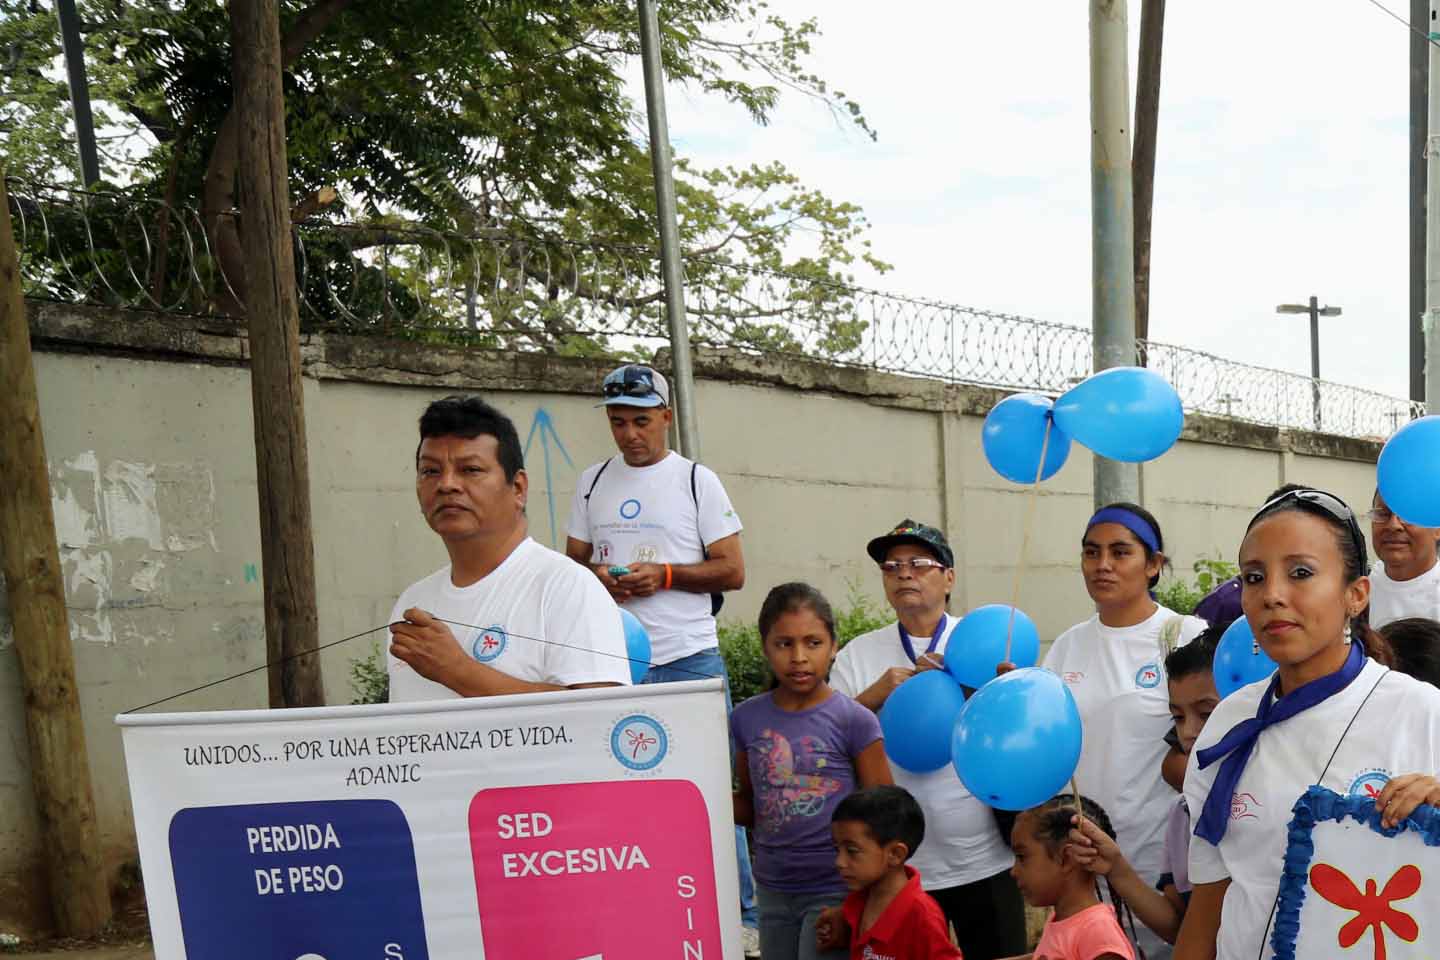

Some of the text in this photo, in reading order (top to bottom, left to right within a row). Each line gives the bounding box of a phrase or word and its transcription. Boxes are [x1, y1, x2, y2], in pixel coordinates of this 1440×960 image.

[183, 726, 573, 766] UNIDOS... POR UNA ESPERANZA DE VIDA.
[345, 763, 421, 787] ADANIC
[246, 823, 341, 853] PERDIDA
[497, 812, 553, 839] SED
[502, 845, 650, 878] EXCESIVA
[255, 864, 343, 895] DE PESO
